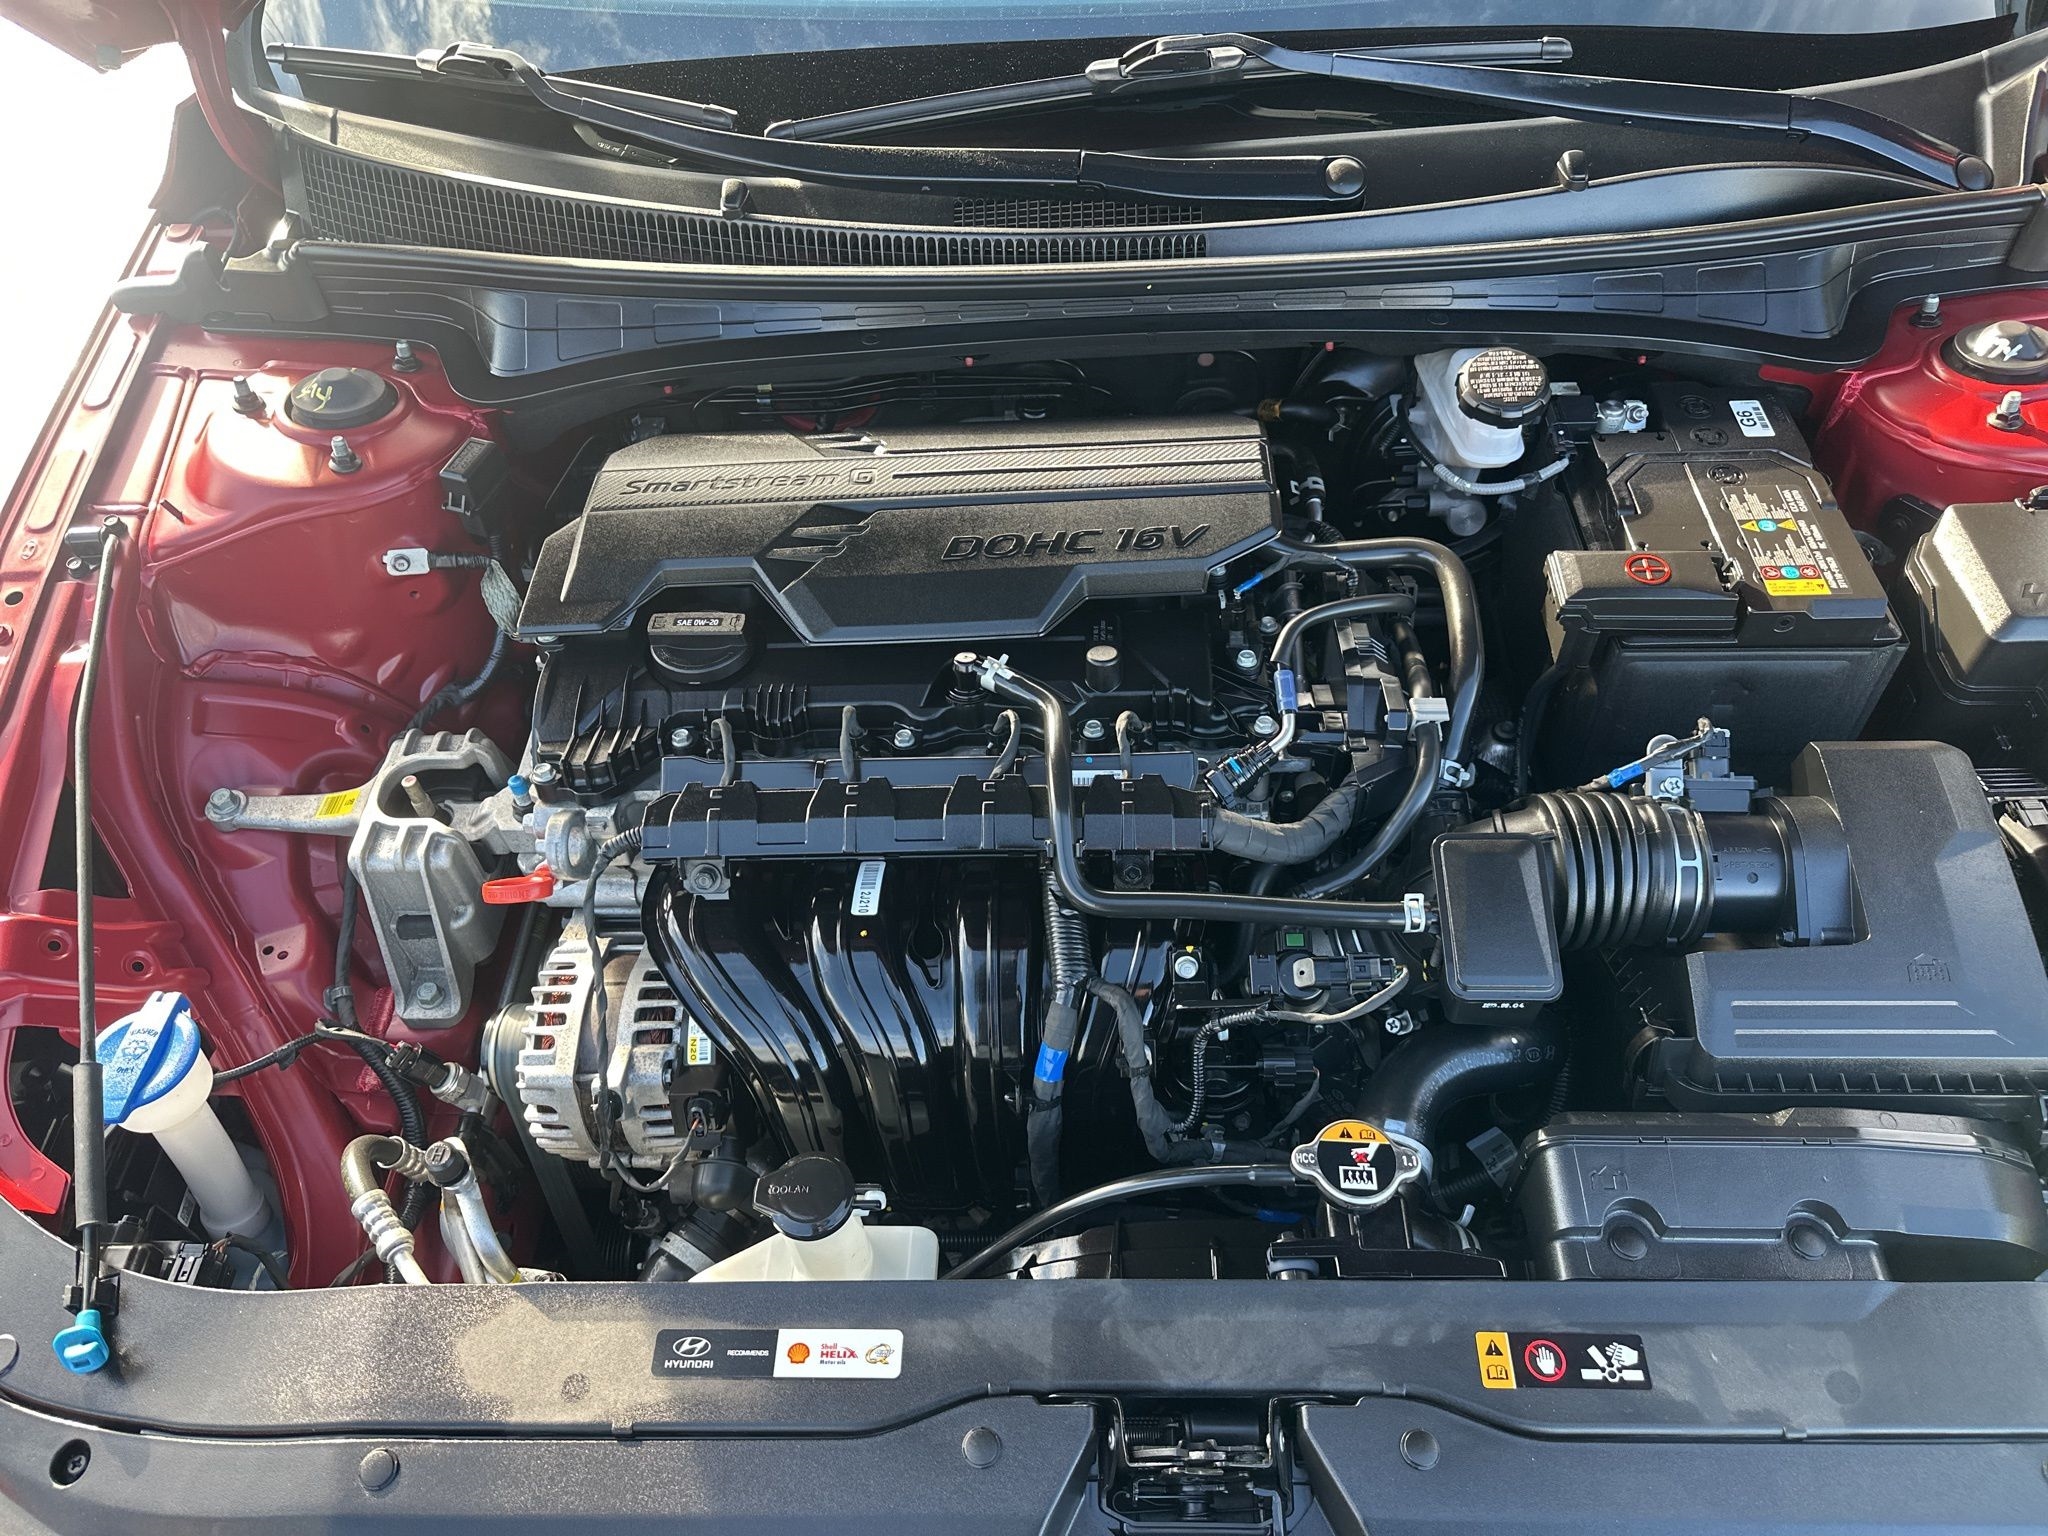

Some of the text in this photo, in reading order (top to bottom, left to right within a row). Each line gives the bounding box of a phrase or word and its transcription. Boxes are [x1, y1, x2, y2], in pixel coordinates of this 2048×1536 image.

[1736, 410, 1757, 427] G6
[619, 473, 840, 495] Smartstream
[941, 524, 1210, 560] DOHC 16V
[693, 618, 719, 626] 0W-20
[858, 891, 871, 913] 2J210
[1296, 1153, 1417, 1166] HCC 1.1
[820, 1348, 857, 1358] HELIX
[664, 1360, 713, 1368] HYUNDAI
